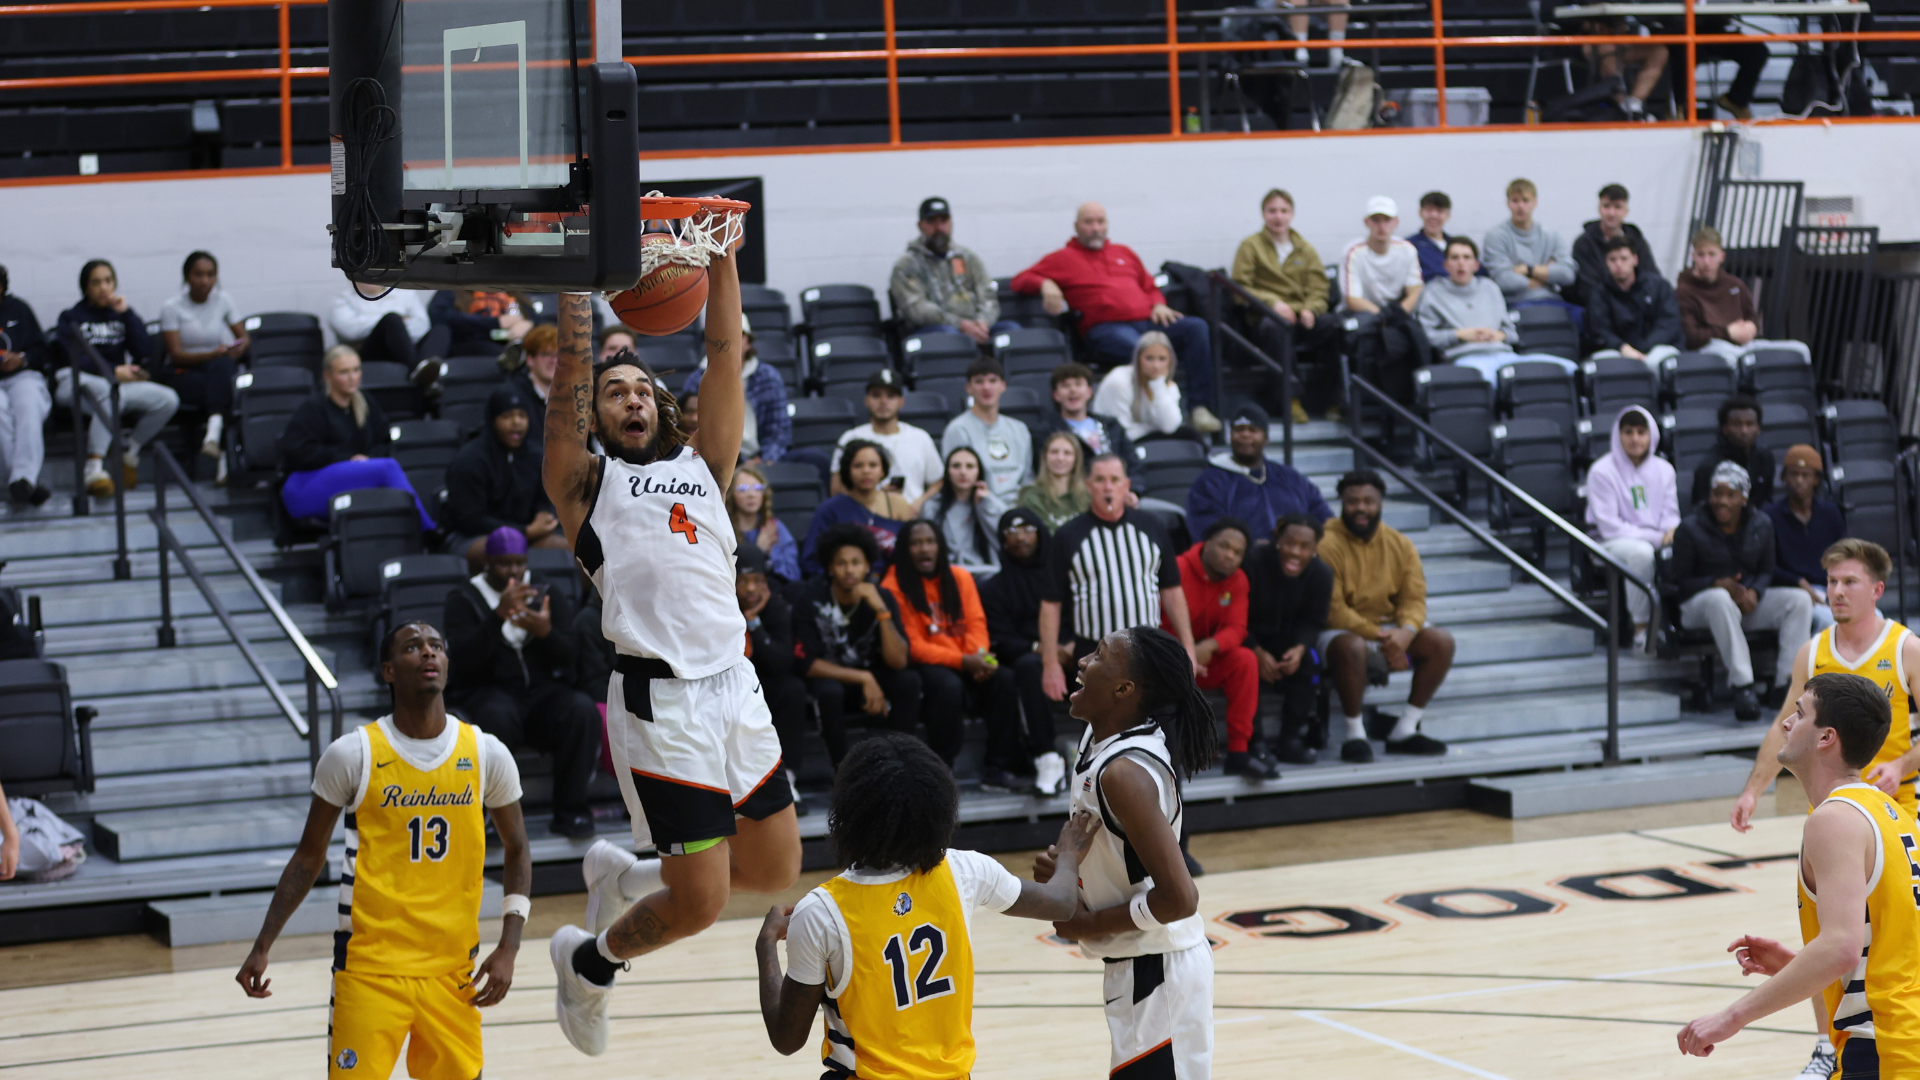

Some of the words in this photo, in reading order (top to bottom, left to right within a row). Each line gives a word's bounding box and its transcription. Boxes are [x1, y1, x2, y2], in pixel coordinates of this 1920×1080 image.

[631, 264, 695, 300] SPALDING
[628, 475, 707, 498] Union
[668, 502, 699, 545] 4
[380, 783, 474, 809] Reinhardt
[407, 815, 450, 862] 13
[882, 922, 957, 1011] 12
